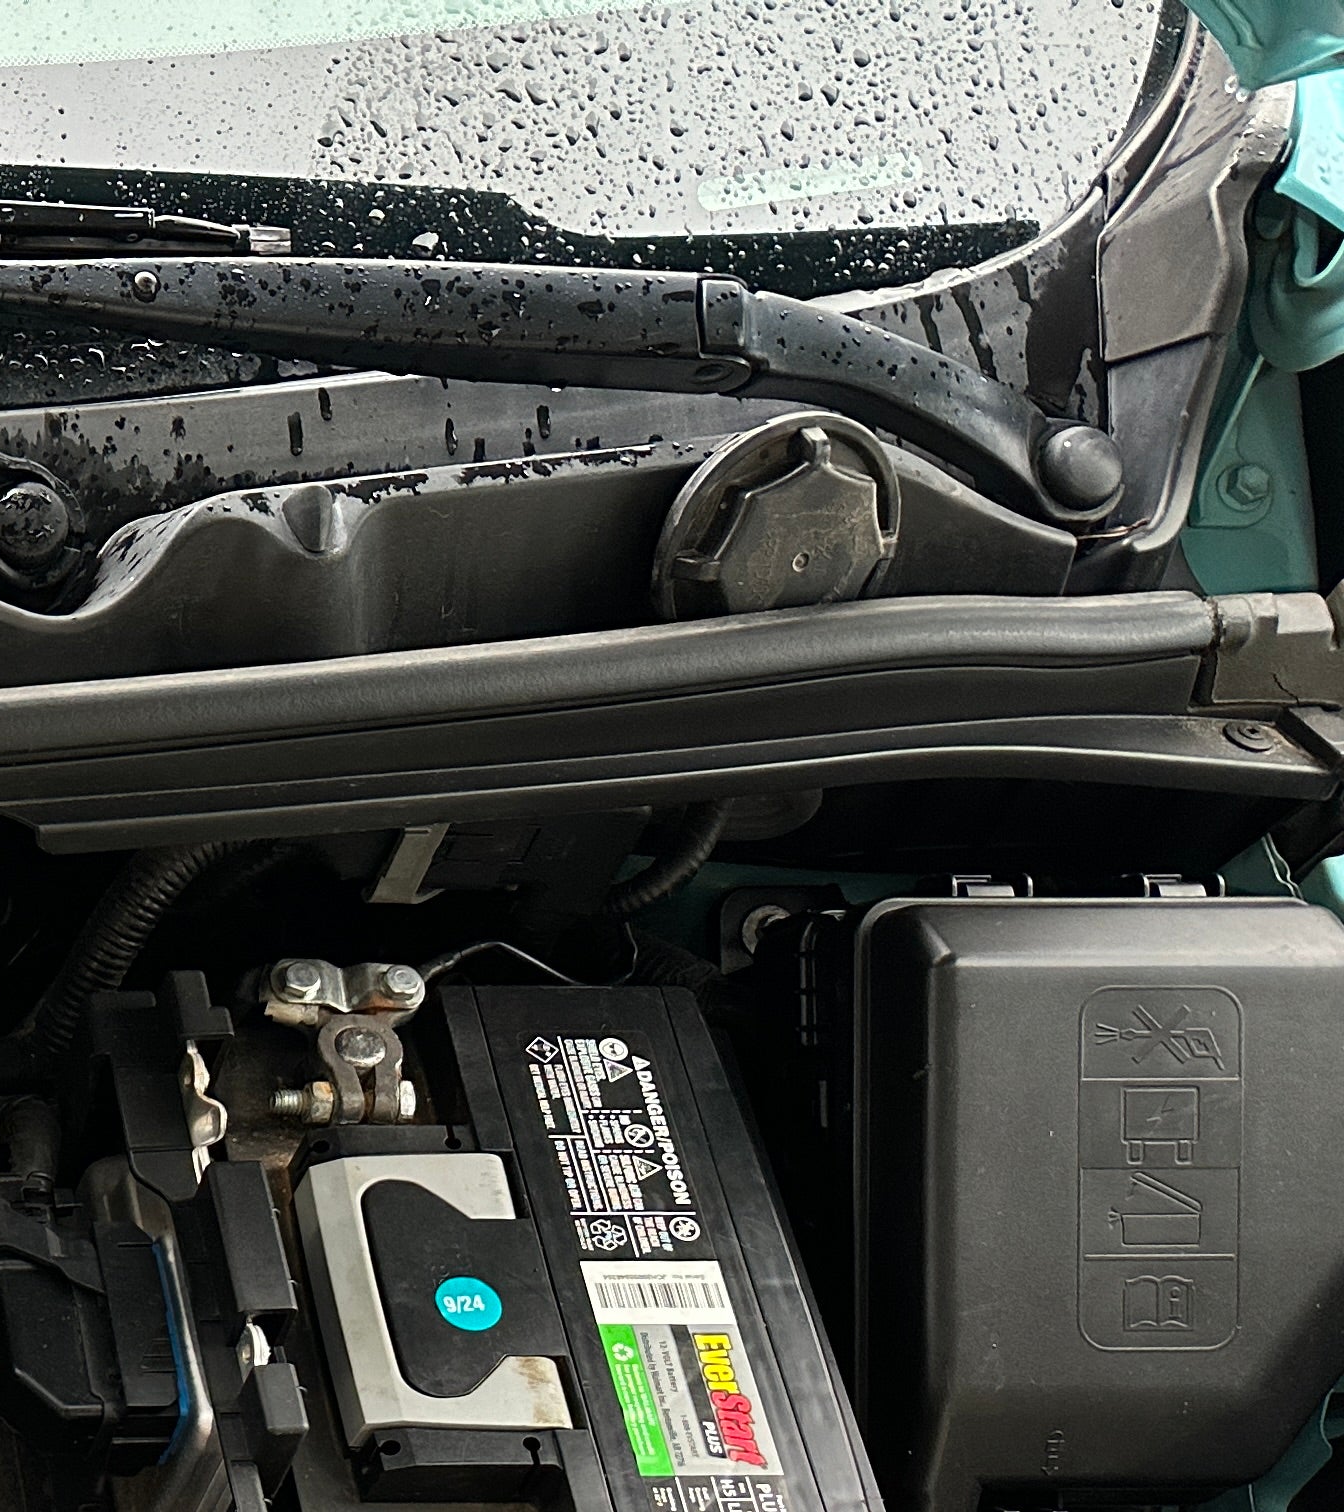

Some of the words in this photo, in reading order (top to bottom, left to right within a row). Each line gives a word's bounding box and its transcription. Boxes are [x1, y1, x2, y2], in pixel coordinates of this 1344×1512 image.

[635, 1070, 692, 1205] DANGER/POISON
[443, 1294, 485, 1314] 9/24
[690, 1333, 772, 1466] EverStart
[702, 1421, 723, 1453] PLUS
[719, 1479, 738, 1497] H5
